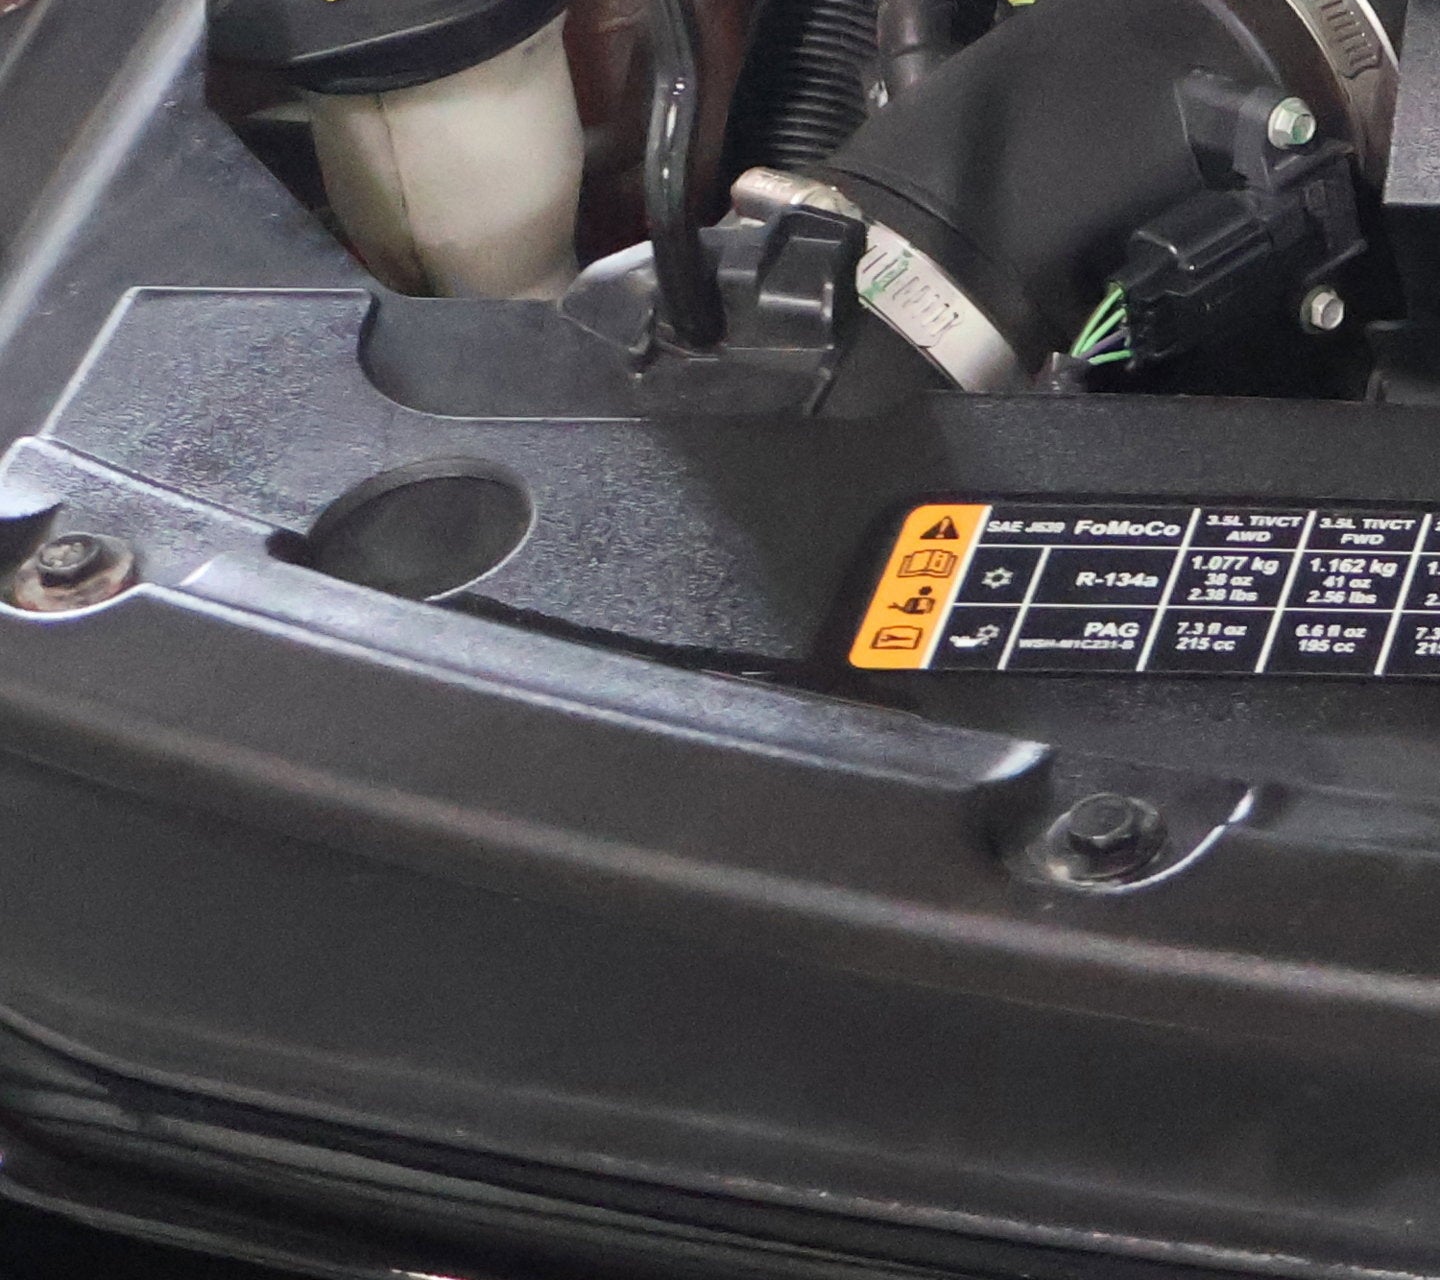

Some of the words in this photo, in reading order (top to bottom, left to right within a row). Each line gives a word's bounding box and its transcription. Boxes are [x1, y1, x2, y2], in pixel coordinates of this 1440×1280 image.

[1206, 515, 1244, 526] 3.5L
[1319, 517, 1357, 528] 3.5L
[987, 520, 1022, 533] SAE
[1074, 520, 1181, 537] FoMoCo
[1226, 530, 1272, 542] AWD
[1340, 533, 1385, 545] FWD
[1191, 555, 1249, 571] 1.077
[1251, 557, 1279, 575] kg
[1310, 558, 1366, 573] 1.162
[1369, 559, 1398, 577] kg
[1075, 571, 1159, 588] R-134a
[1204, 573, 1228, 586] 38
[1230, 576, 1254, 587] oz
[1322, 576, 1345, 588] 41
[1349, 578, 1372, 589] oz
[1187, 588, 1227, 601] 2.38
[1229, 589, 1258, 602] lbs
[1306, 591, 1346, 604] 2.56
[1348, 591, 1377, 605] lbs
[1084, 622, 1139, 638] PAG
[1176, 622, 1204, 635] 7.3
[1223, 625, 1248, 636] oz
[1295, 624, 1324, 638] 6.6
[1343, 627, 1367, 639] oz
[1175, 637, 1210, 651] 215
[1212, 640, 1236, 651] cc
[1298, 639, 1330, 653] 195
[1332, 642, 1356, 653] cc
